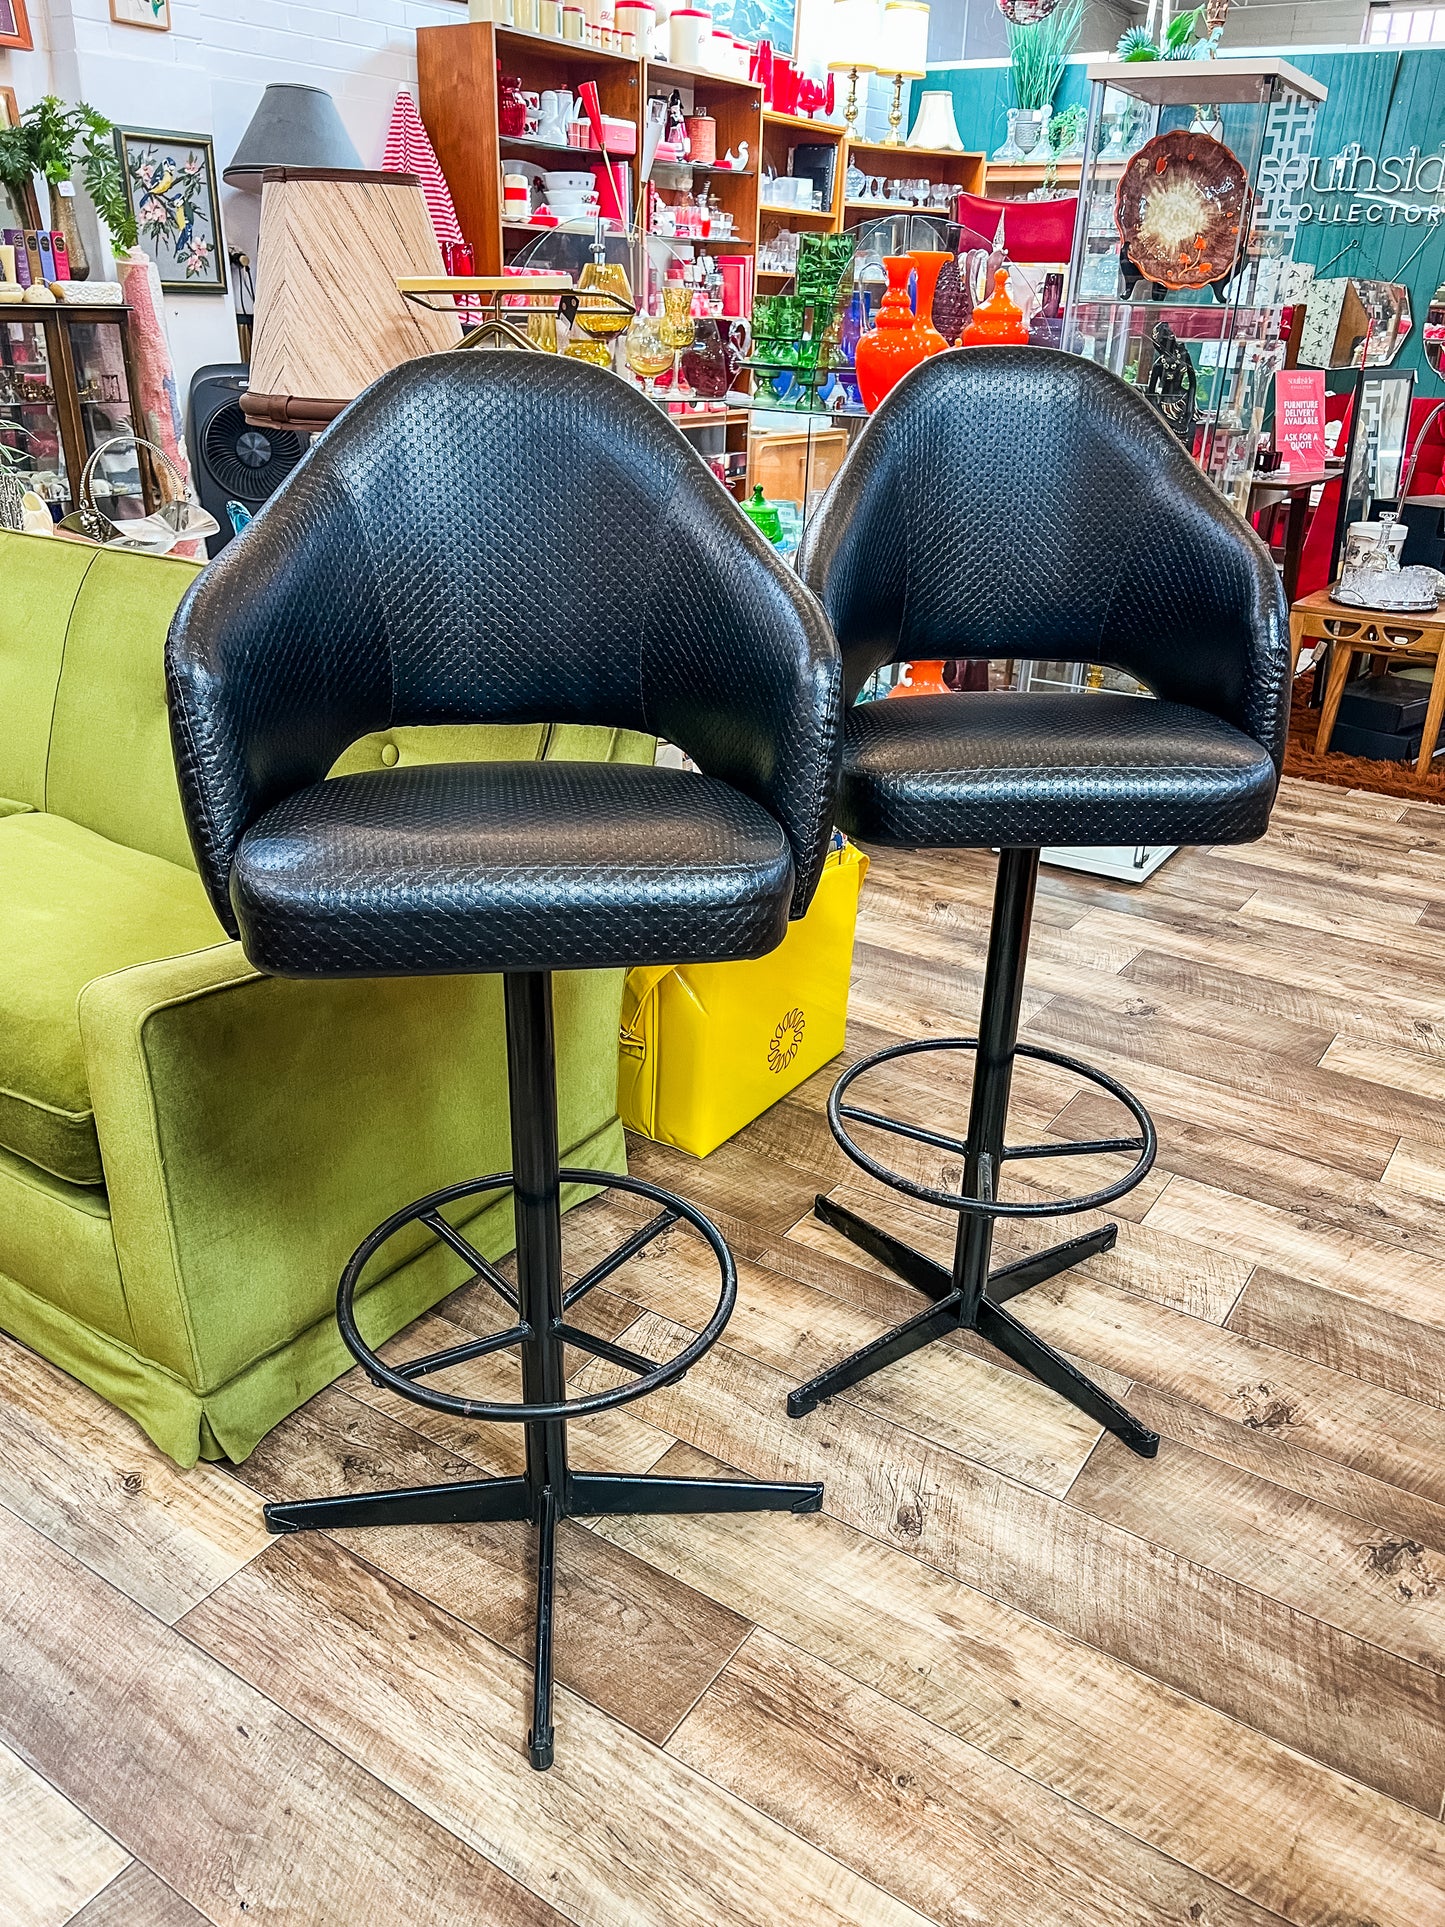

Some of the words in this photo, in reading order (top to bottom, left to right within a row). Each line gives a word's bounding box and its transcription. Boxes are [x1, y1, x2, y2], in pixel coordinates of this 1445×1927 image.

[1277, 202, 1441, 223] COLLECTOR
[1284, 400, 1319, 409] FURNITURE
[1285, 409, 1316, 417] DELIVERY
[1284, 417, 1319, 425] AVAILABLE
[1284, 433, 1298, 442] ASK
[1299, 433, 1312, 441] FOR
[1313, 433, 1319, 441] A
[1290, 441, 1312, 450] QUOTE
